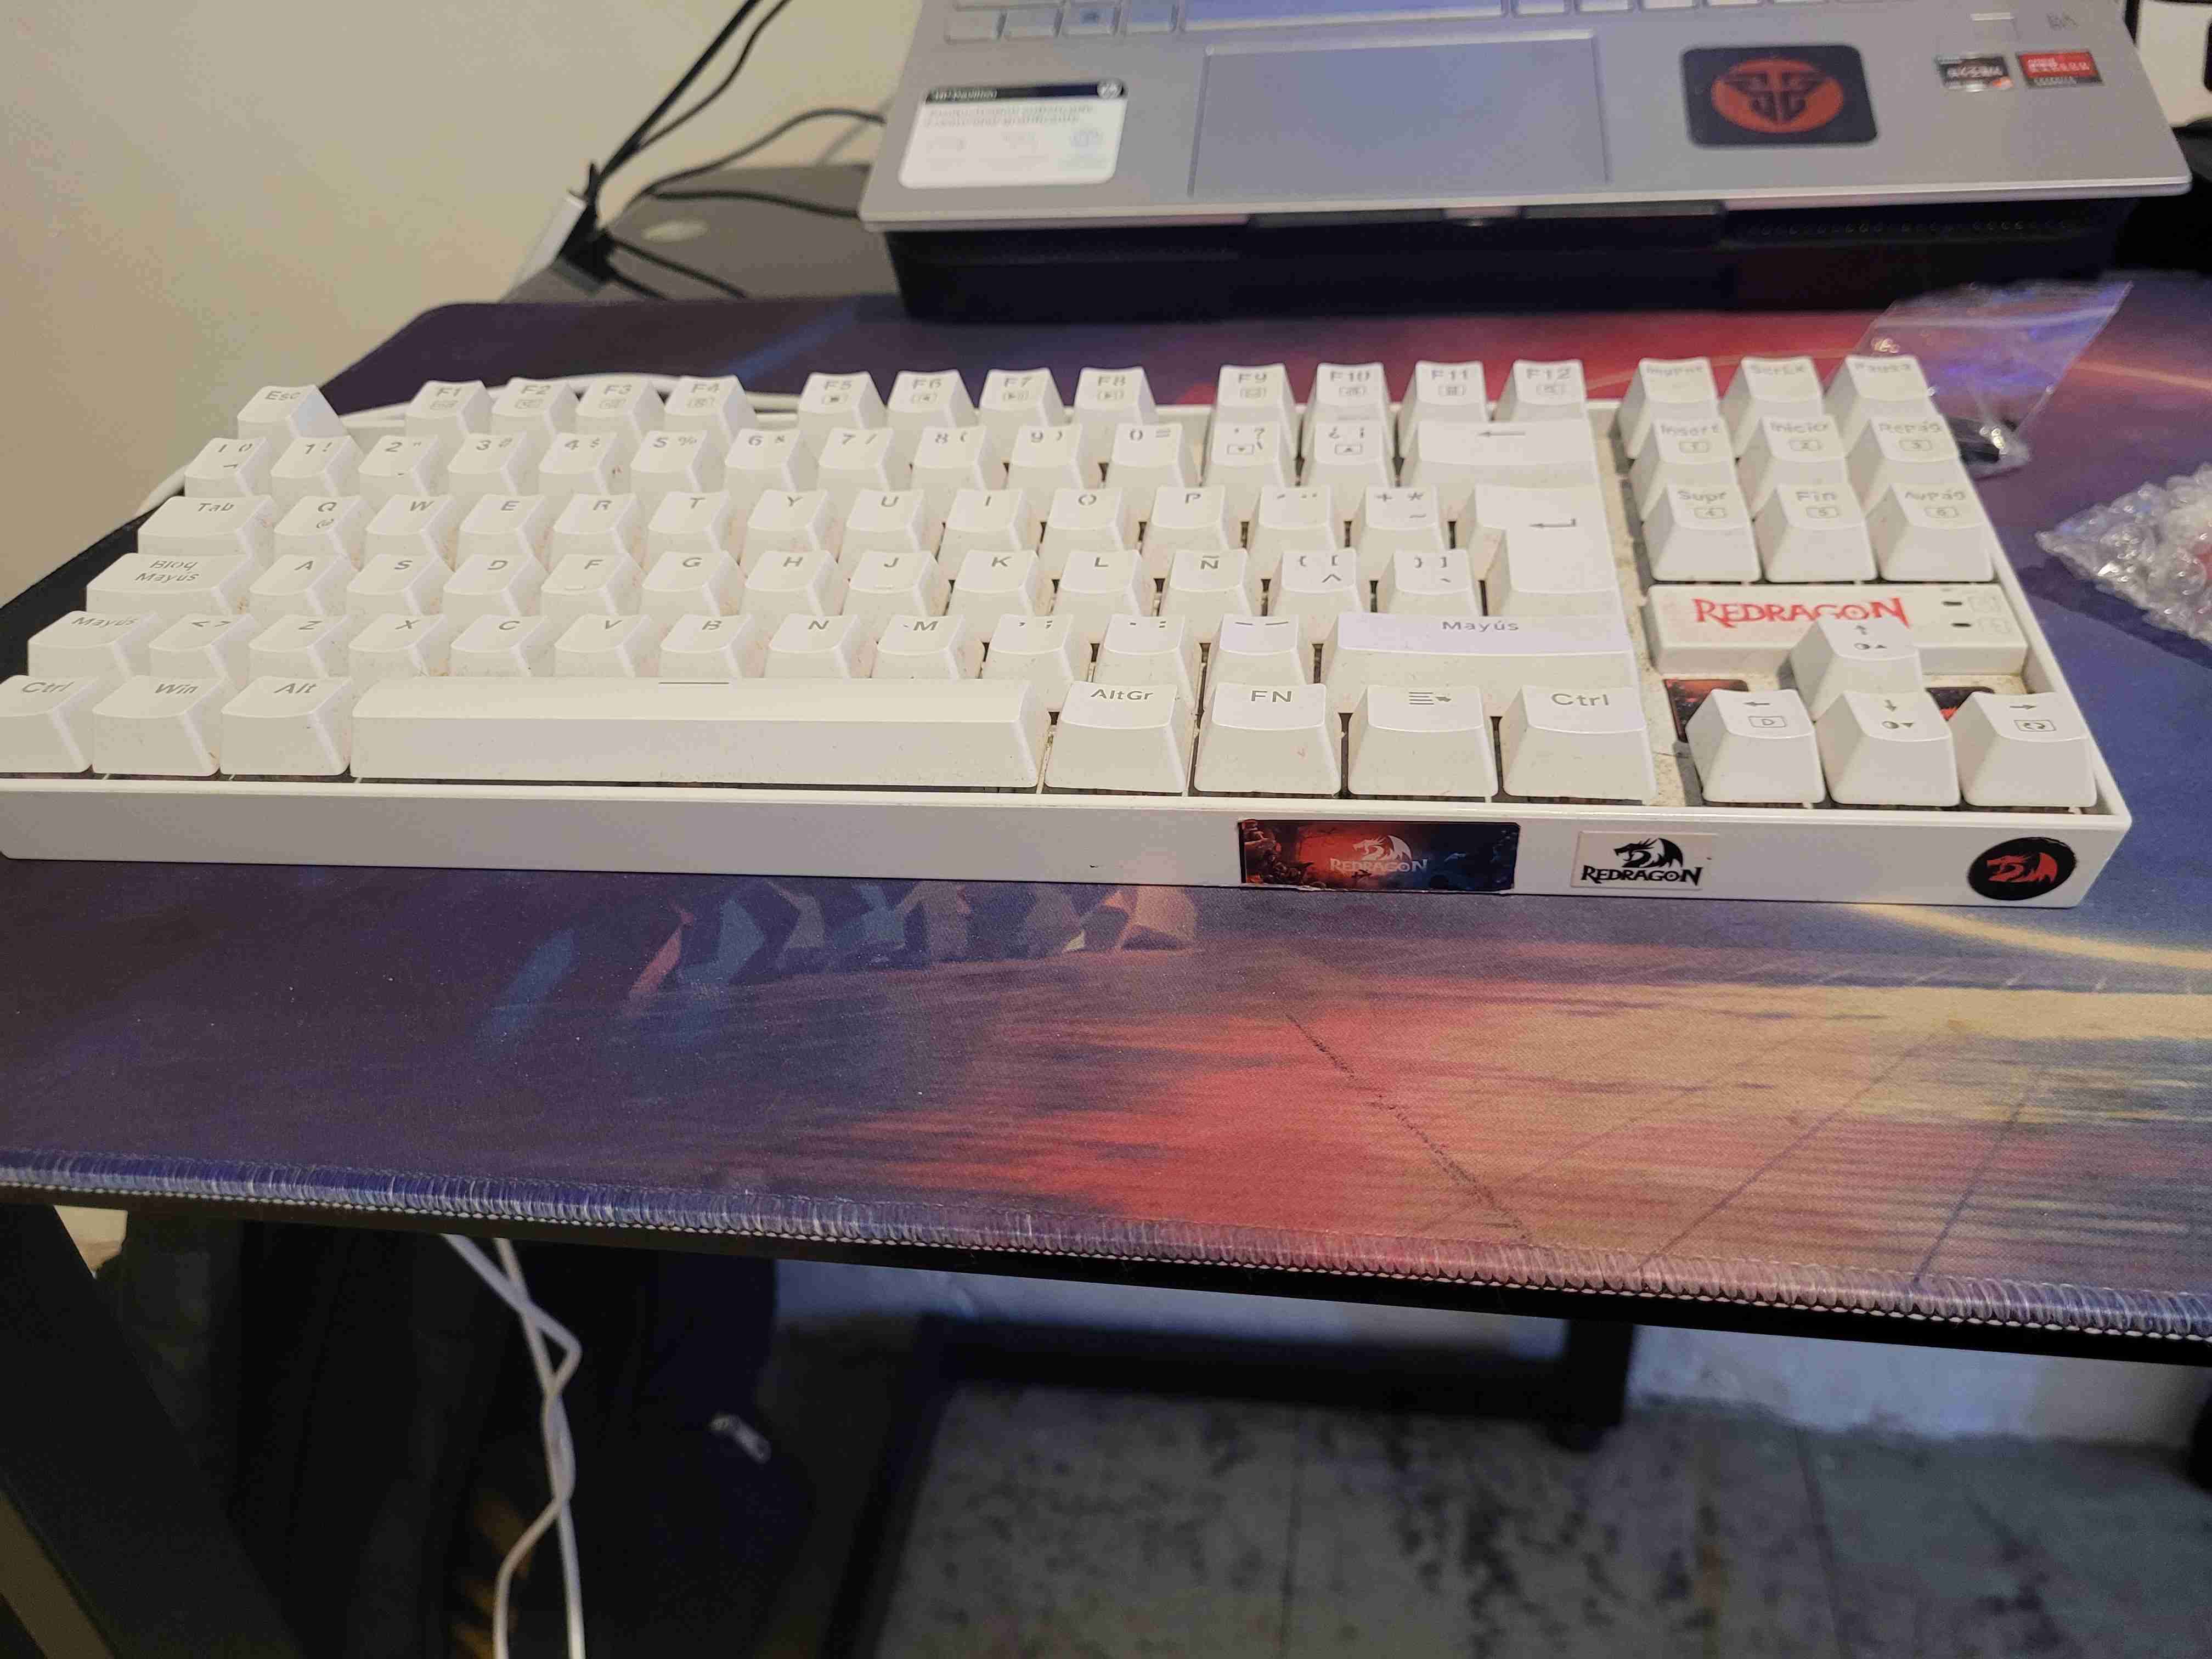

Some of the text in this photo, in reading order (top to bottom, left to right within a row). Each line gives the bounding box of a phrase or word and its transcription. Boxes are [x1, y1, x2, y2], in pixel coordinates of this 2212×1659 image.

[1239, 373, 1267, 383] F9
[1331, 371, 1369, 381] F10
[1432, 369, 1468, 380] F11
[1526, 369, 1571, 379] F12
[825, 380, 851, 390] F5
[913, 379, 941, 390] F6
[1005, 377, 1032, 387] F7
[1098, 376, 1126, 386] F8
[437, 386, 461, 397] F1
[522, 385, 550, 394] F2
[603, 385, 631, 394] F3
[692, 383, 719, 393] F4
[265, 391, 301, 400] Esc
[1660, 424, 1719, 436] Insert
[1770, 422, 1829, 434] Inicio
[748, 435, 764, 447] 6
[842, 433, 856, 445] 7
[935, 433, 949, 444] 8
[1031, 430, 1043, 443] 9
[385, 442, 403, 452] 2
[476, 439, 492, 451] 3
[564, 439, 580, 450] 4
[653, 437, 669, 448] 5
[305, 443, 317, 455] 1
[787, 496, 803, 507] Y
[881, 496, 900, 507] U
[1078, 494, 1097, 506] O
[1185, 493, 1201, 504] P
[1375, 493, 1393, 503] +
[1677, 490, 1727, 504] Supr
[1795, 490, 1837, 502] Fin
[198, 502, 235, 512] Tab
[318, 502, 337, 513] Q
[410, 501, 435, 511] W
[501, 500, 520, 511] E
[593, 500, 612, 511] R
[691, 498, 706, 509] T
[317, 519, 334, 529] @
[150, 560, 198, 573] Bloq
[295, 561, 315, 571] A
[394, 560, 413, 571] S
[488, 560, 509, 571] D
[584, 559, 603, 569] F
[682, 557, 702, 568] G
[783, 557, 804, 568] H
[884, 557, 900, 568] J
[992, 557, 1012, 567] K
[1094, 557, 1110, 567] L
[1201, 555, 1220, 569] Ñ
[299, 620, 323, 630] Z
[394, 619, 419, 630] X
[498, 620, 521, 631] C
[604, 620, 623, 630] V
[702, 620, 723, 631] B
[808, 620, 830, 631] N
[912, 620, 939, 631] M
[1441, 619, 1519, 633] Mayús
[21, 680, 75, 693] Ctrl
[154, 682, 199, 694] Win
[274, 682, 318, 694] Alt
[1090, 688, 1154, 702] AltGr
[1251, 690, 1292, 703] FN
[1550, 692, 1610, 707] Ctrl
[1329, 858, 1429, 877] REDRAGON
[1581, 865, 1703, 887] REDRAGON
